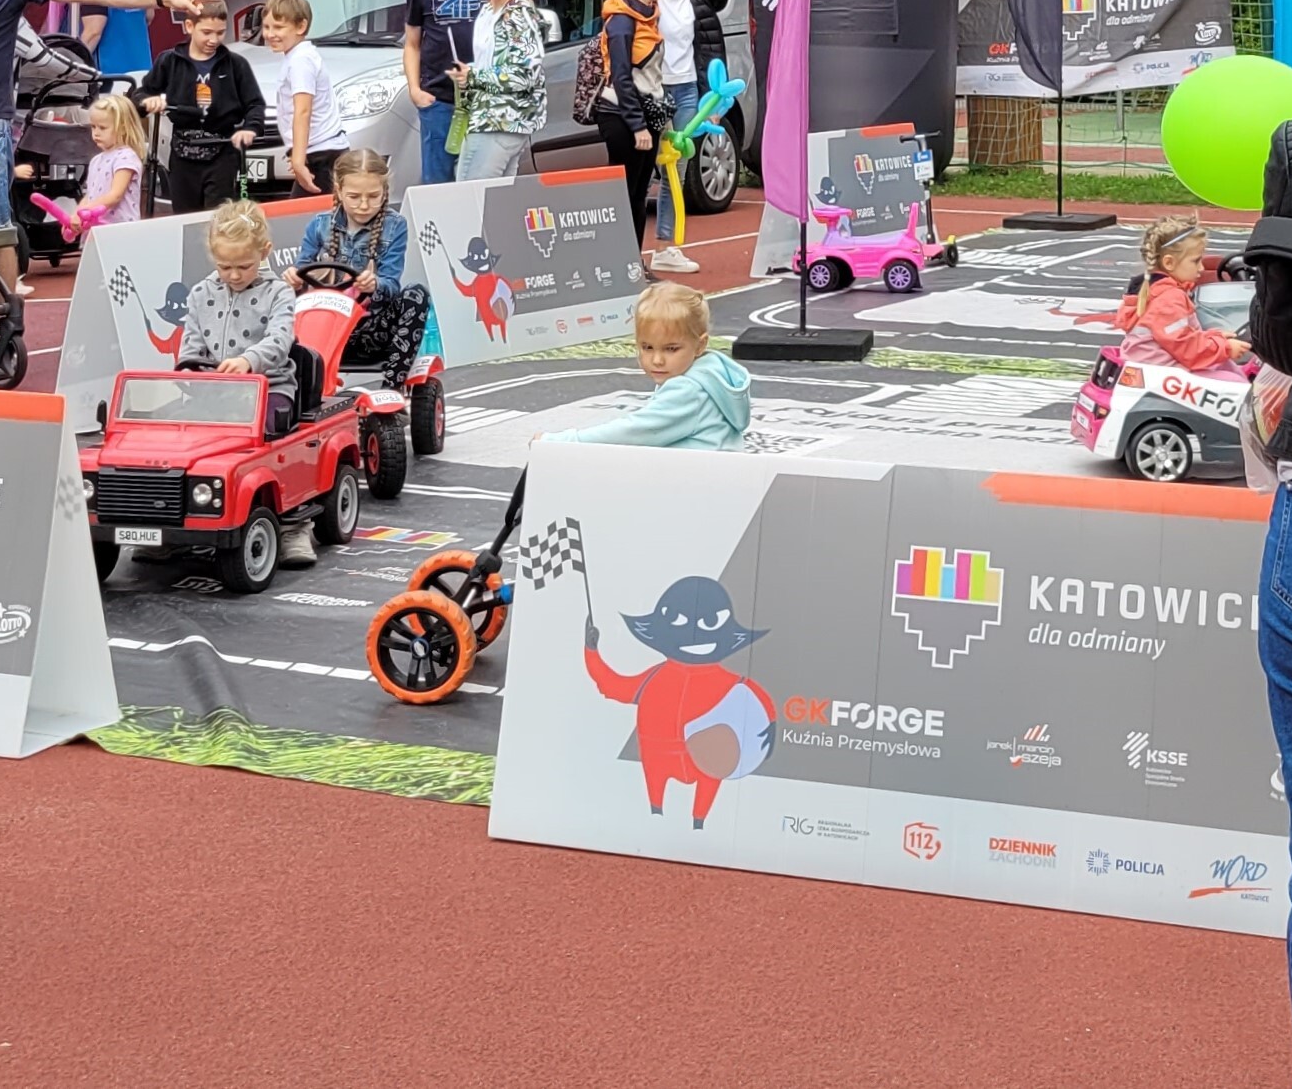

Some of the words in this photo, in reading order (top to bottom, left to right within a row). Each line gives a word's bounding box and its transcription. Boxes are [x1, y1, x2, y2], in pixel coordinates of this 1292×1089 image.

[875, 155, 912, 171] KATOWICE
[559, 207, 617, 228] KATOWICE
[1162, 375, 1239, 422] GKFO
[139, 531, 158, 541] HUE
[1028, 623, 1062, 645] dla
[1068, 627, 1166, 660] odmiany
[783, 695, 945, 737] GKFORGE
[782, 729, 833, 747] Kuźnia
[838, 734, 941, 758] Przemysłowa
[986, 739, 1012, 751] jarek
[1017, 743, 1055, 755] marcin
[1020, 752, 1061, 768] szeja
[1146, 749, 1188, 767] KSSE
[909, 833, 934, 850] 112
[989, 837, 1057, 857] DZIENNIK
[1115, 859, 1165, 876] POLICJA
[1209, 855, 1268, 888] WORD
